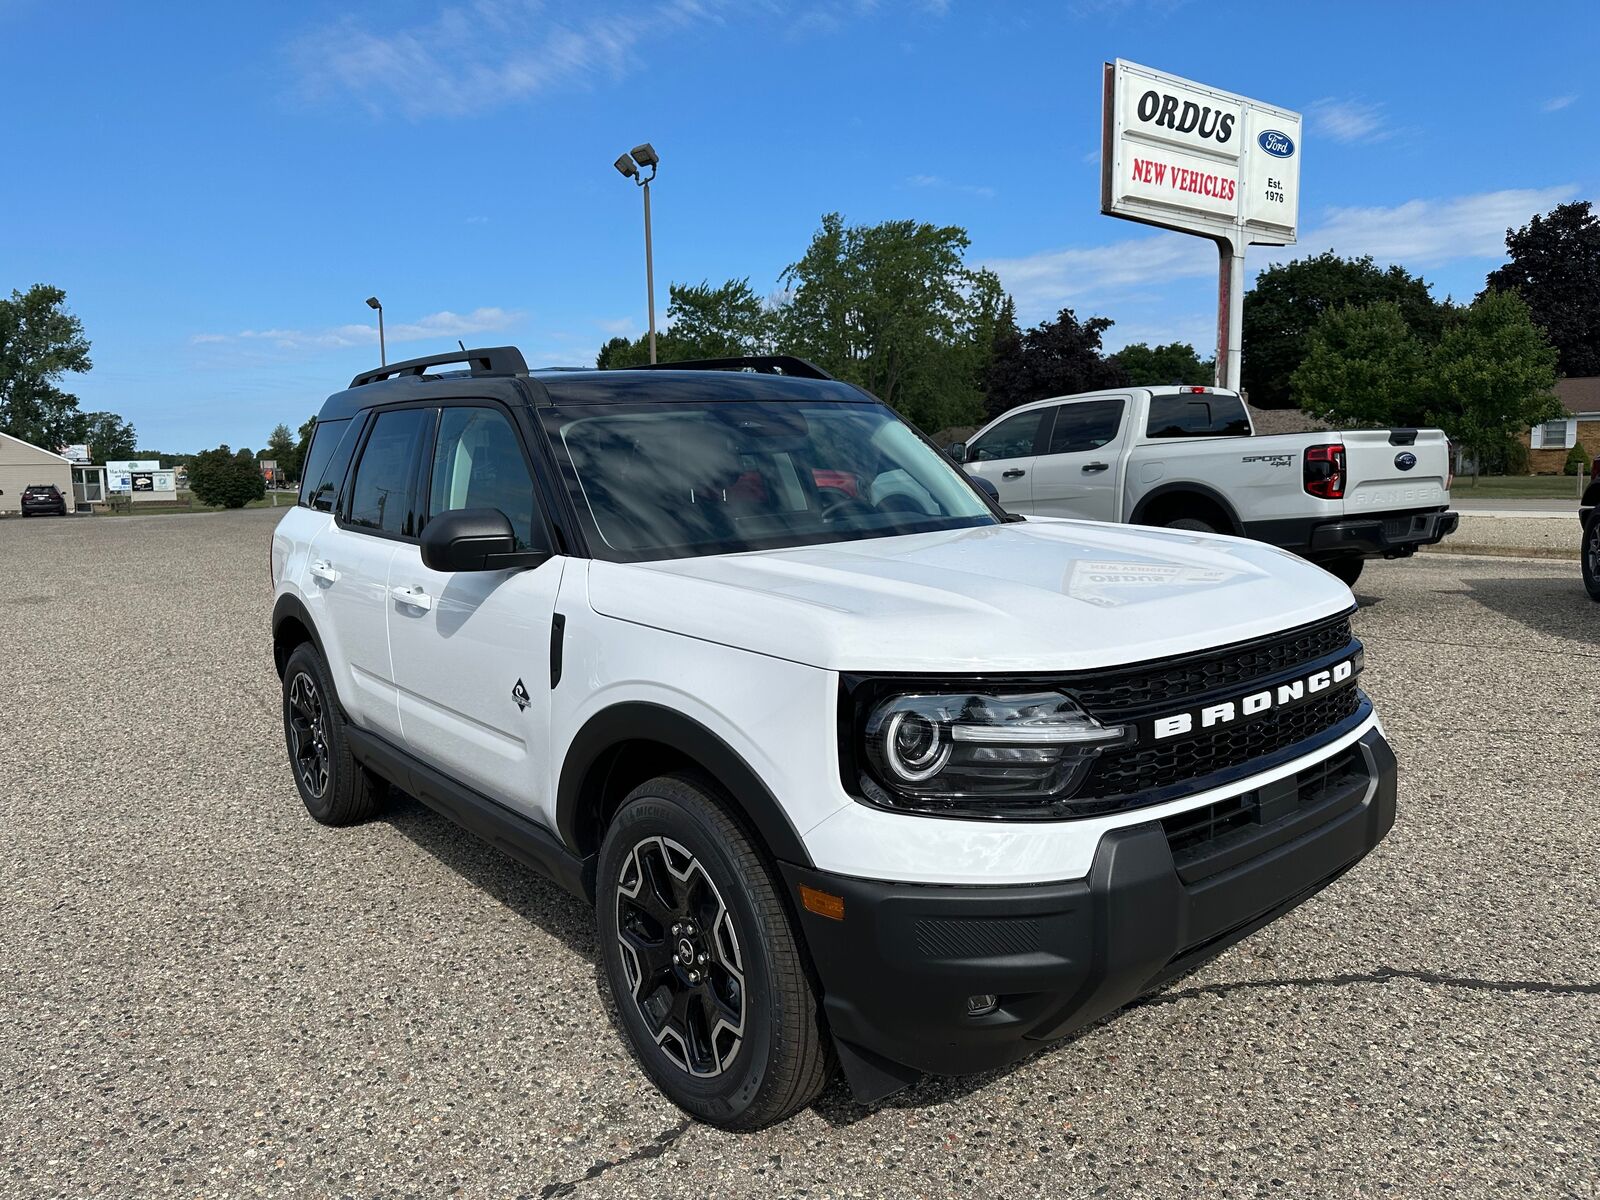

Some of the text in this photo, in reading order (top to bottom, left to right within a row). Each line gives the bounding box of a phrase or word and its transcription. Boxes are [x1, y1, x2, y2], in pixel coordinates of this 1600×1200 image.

[1137, 90, 1235, 143] ORDUS
[1265, 133, 1288, 154] Ford
[1132, 158, 1235, 201] NEW VEHICLES
[1267, 178, 1283, 190] Est.
[1265, 191, 1284, 203] 1976
[1241, 454, 1297, 463] SPORT
[1356, 487, 1440, 505] RANGER
[1154, 660, 1351, 739] BRONCO
